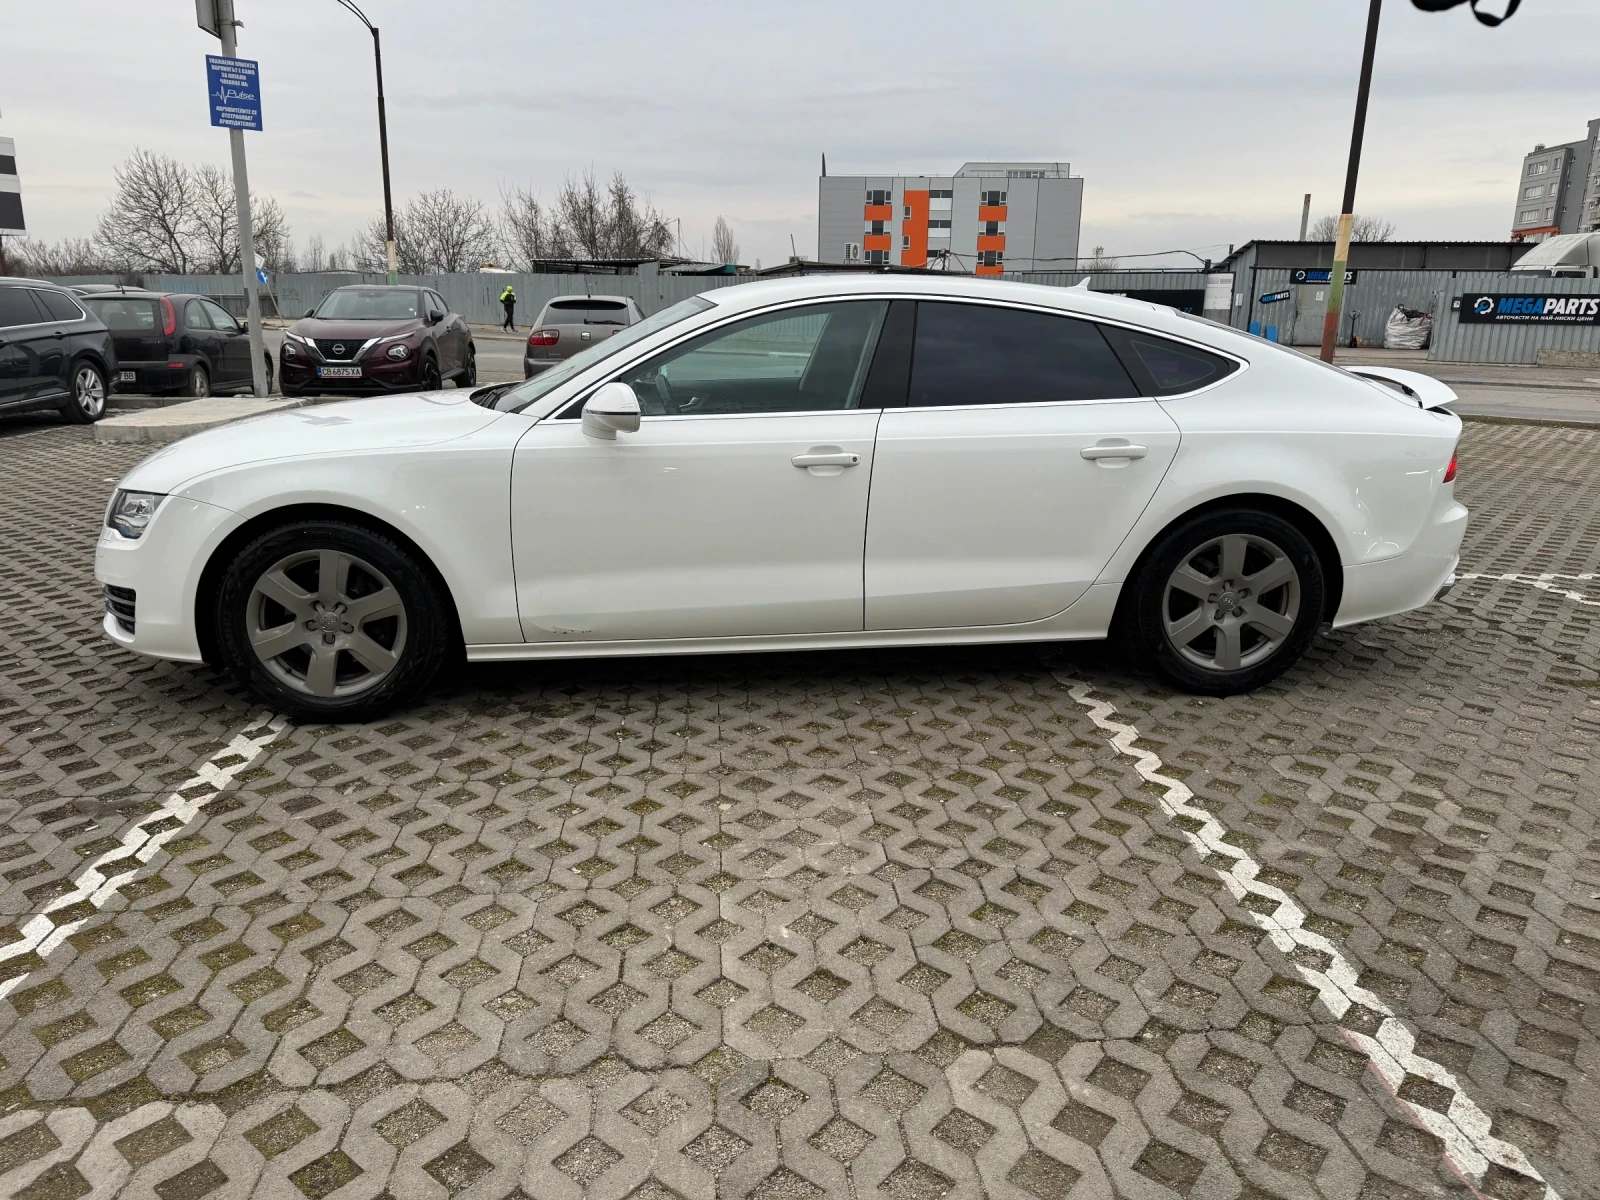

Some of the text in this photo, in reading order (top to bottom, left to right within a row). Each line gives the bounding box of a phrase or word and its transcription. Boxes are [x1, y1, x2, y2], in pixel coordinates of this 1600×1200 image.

[226, 89, 255, 99] Pulse
[1307, 271, 1353, 280] MEGAPTS
[1262, 292, 1289, 302] MEGAPARTS
[1497, 298, 1600, 314] MEGAPARTS
